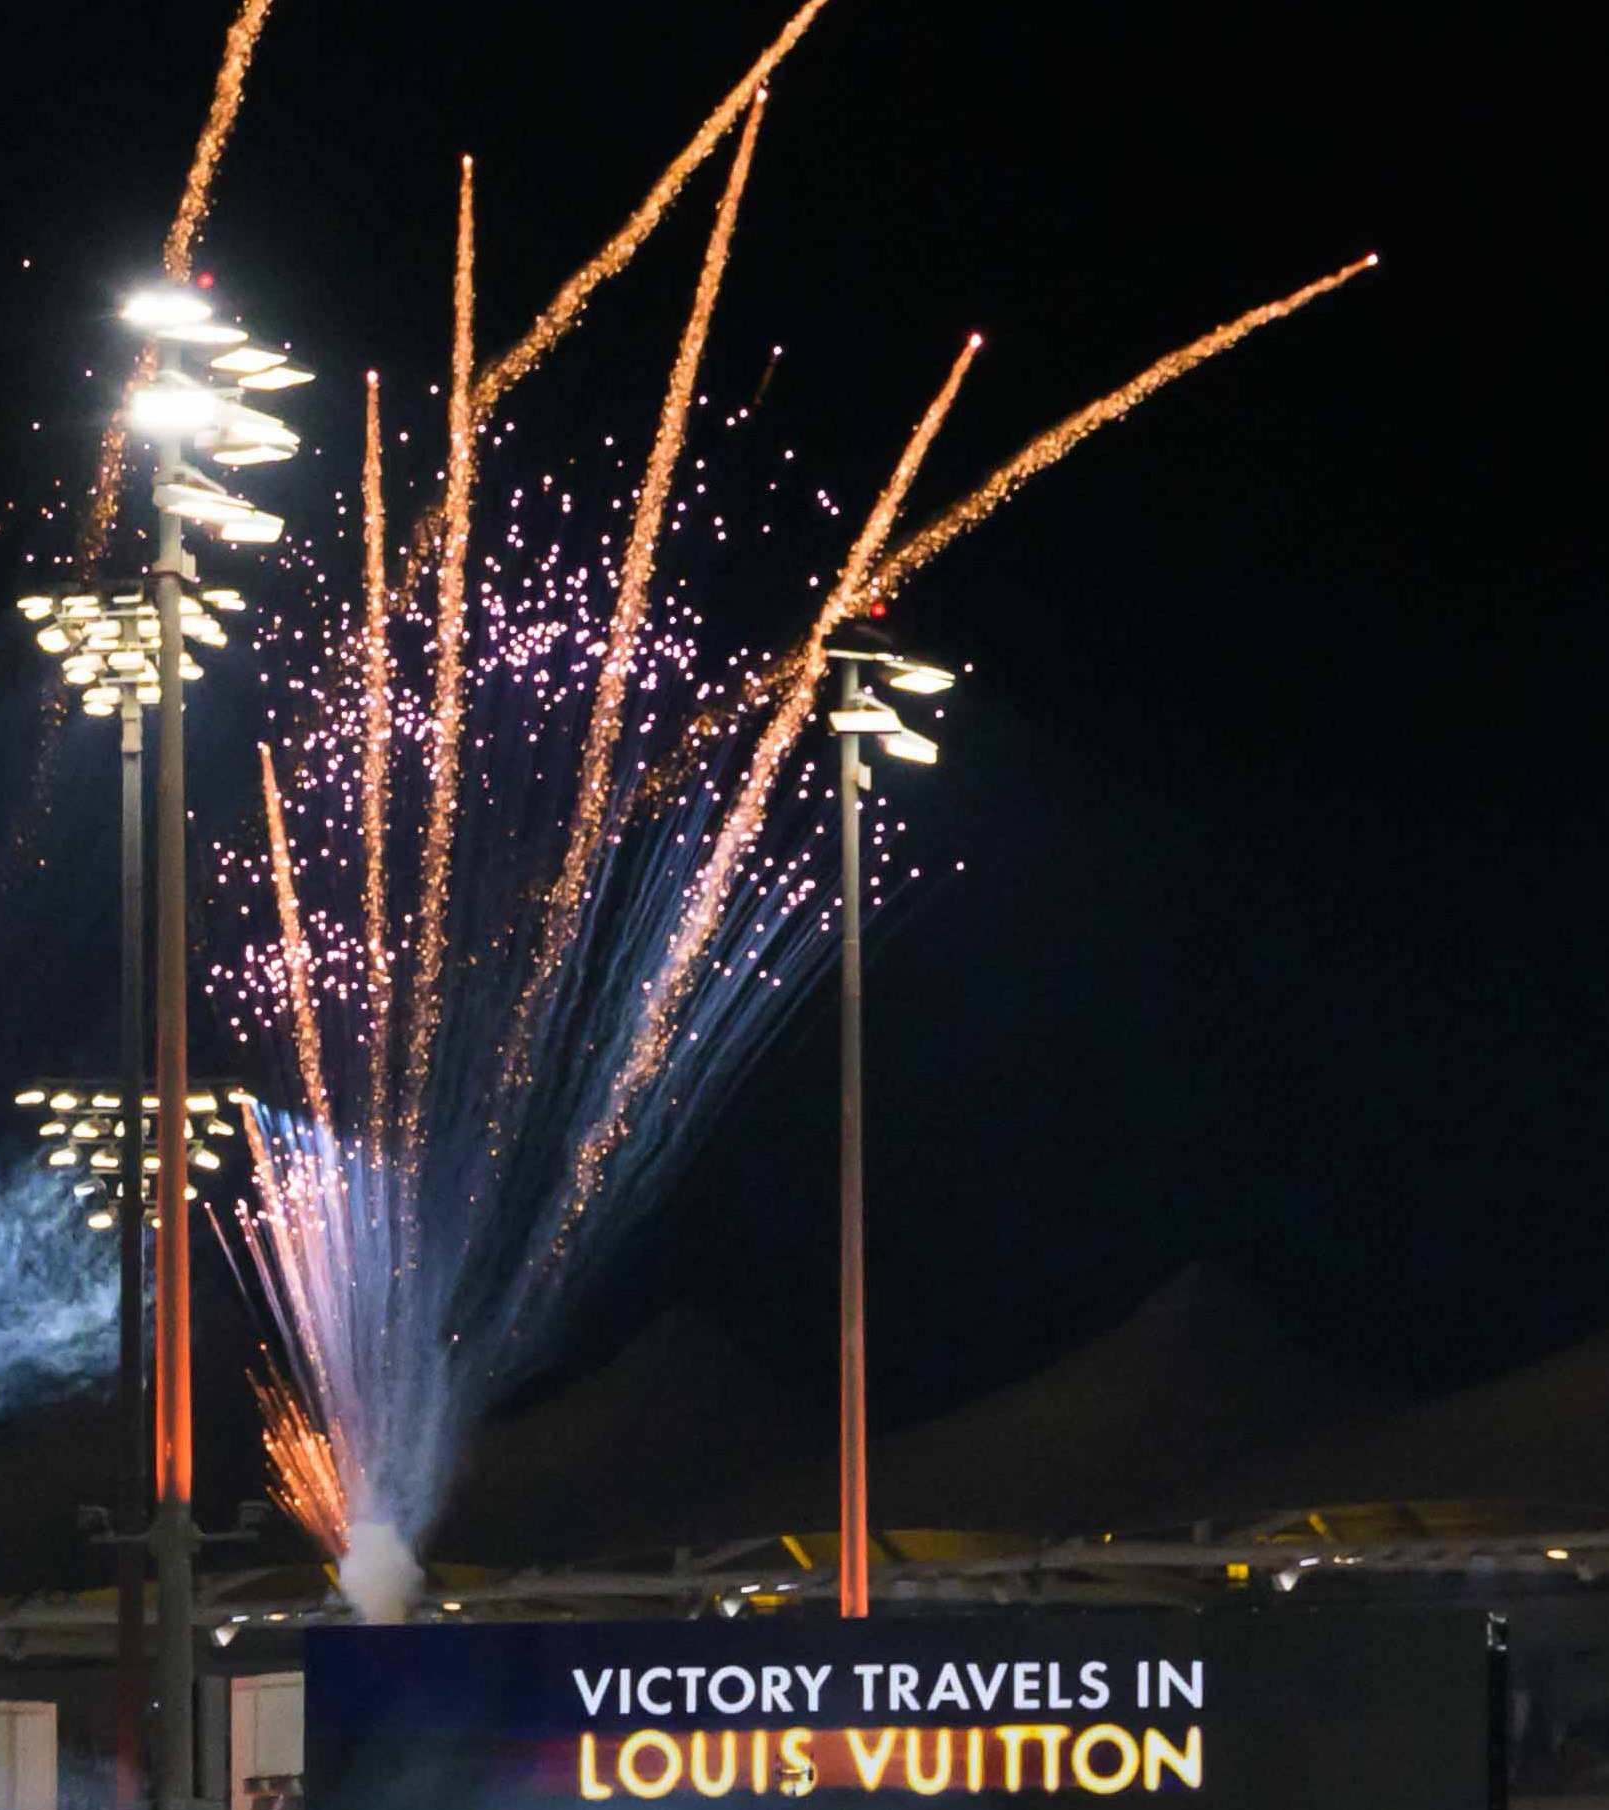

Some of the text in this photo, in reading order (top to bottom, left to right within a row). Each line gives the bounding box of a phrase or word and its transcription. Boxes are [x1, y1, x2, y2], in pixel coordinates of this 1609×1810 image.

[573, 1660, 1204, 1717] VICTORY TRAVELS IN
[579, 1722, 1204, 1801] LOUIS VUITTON
